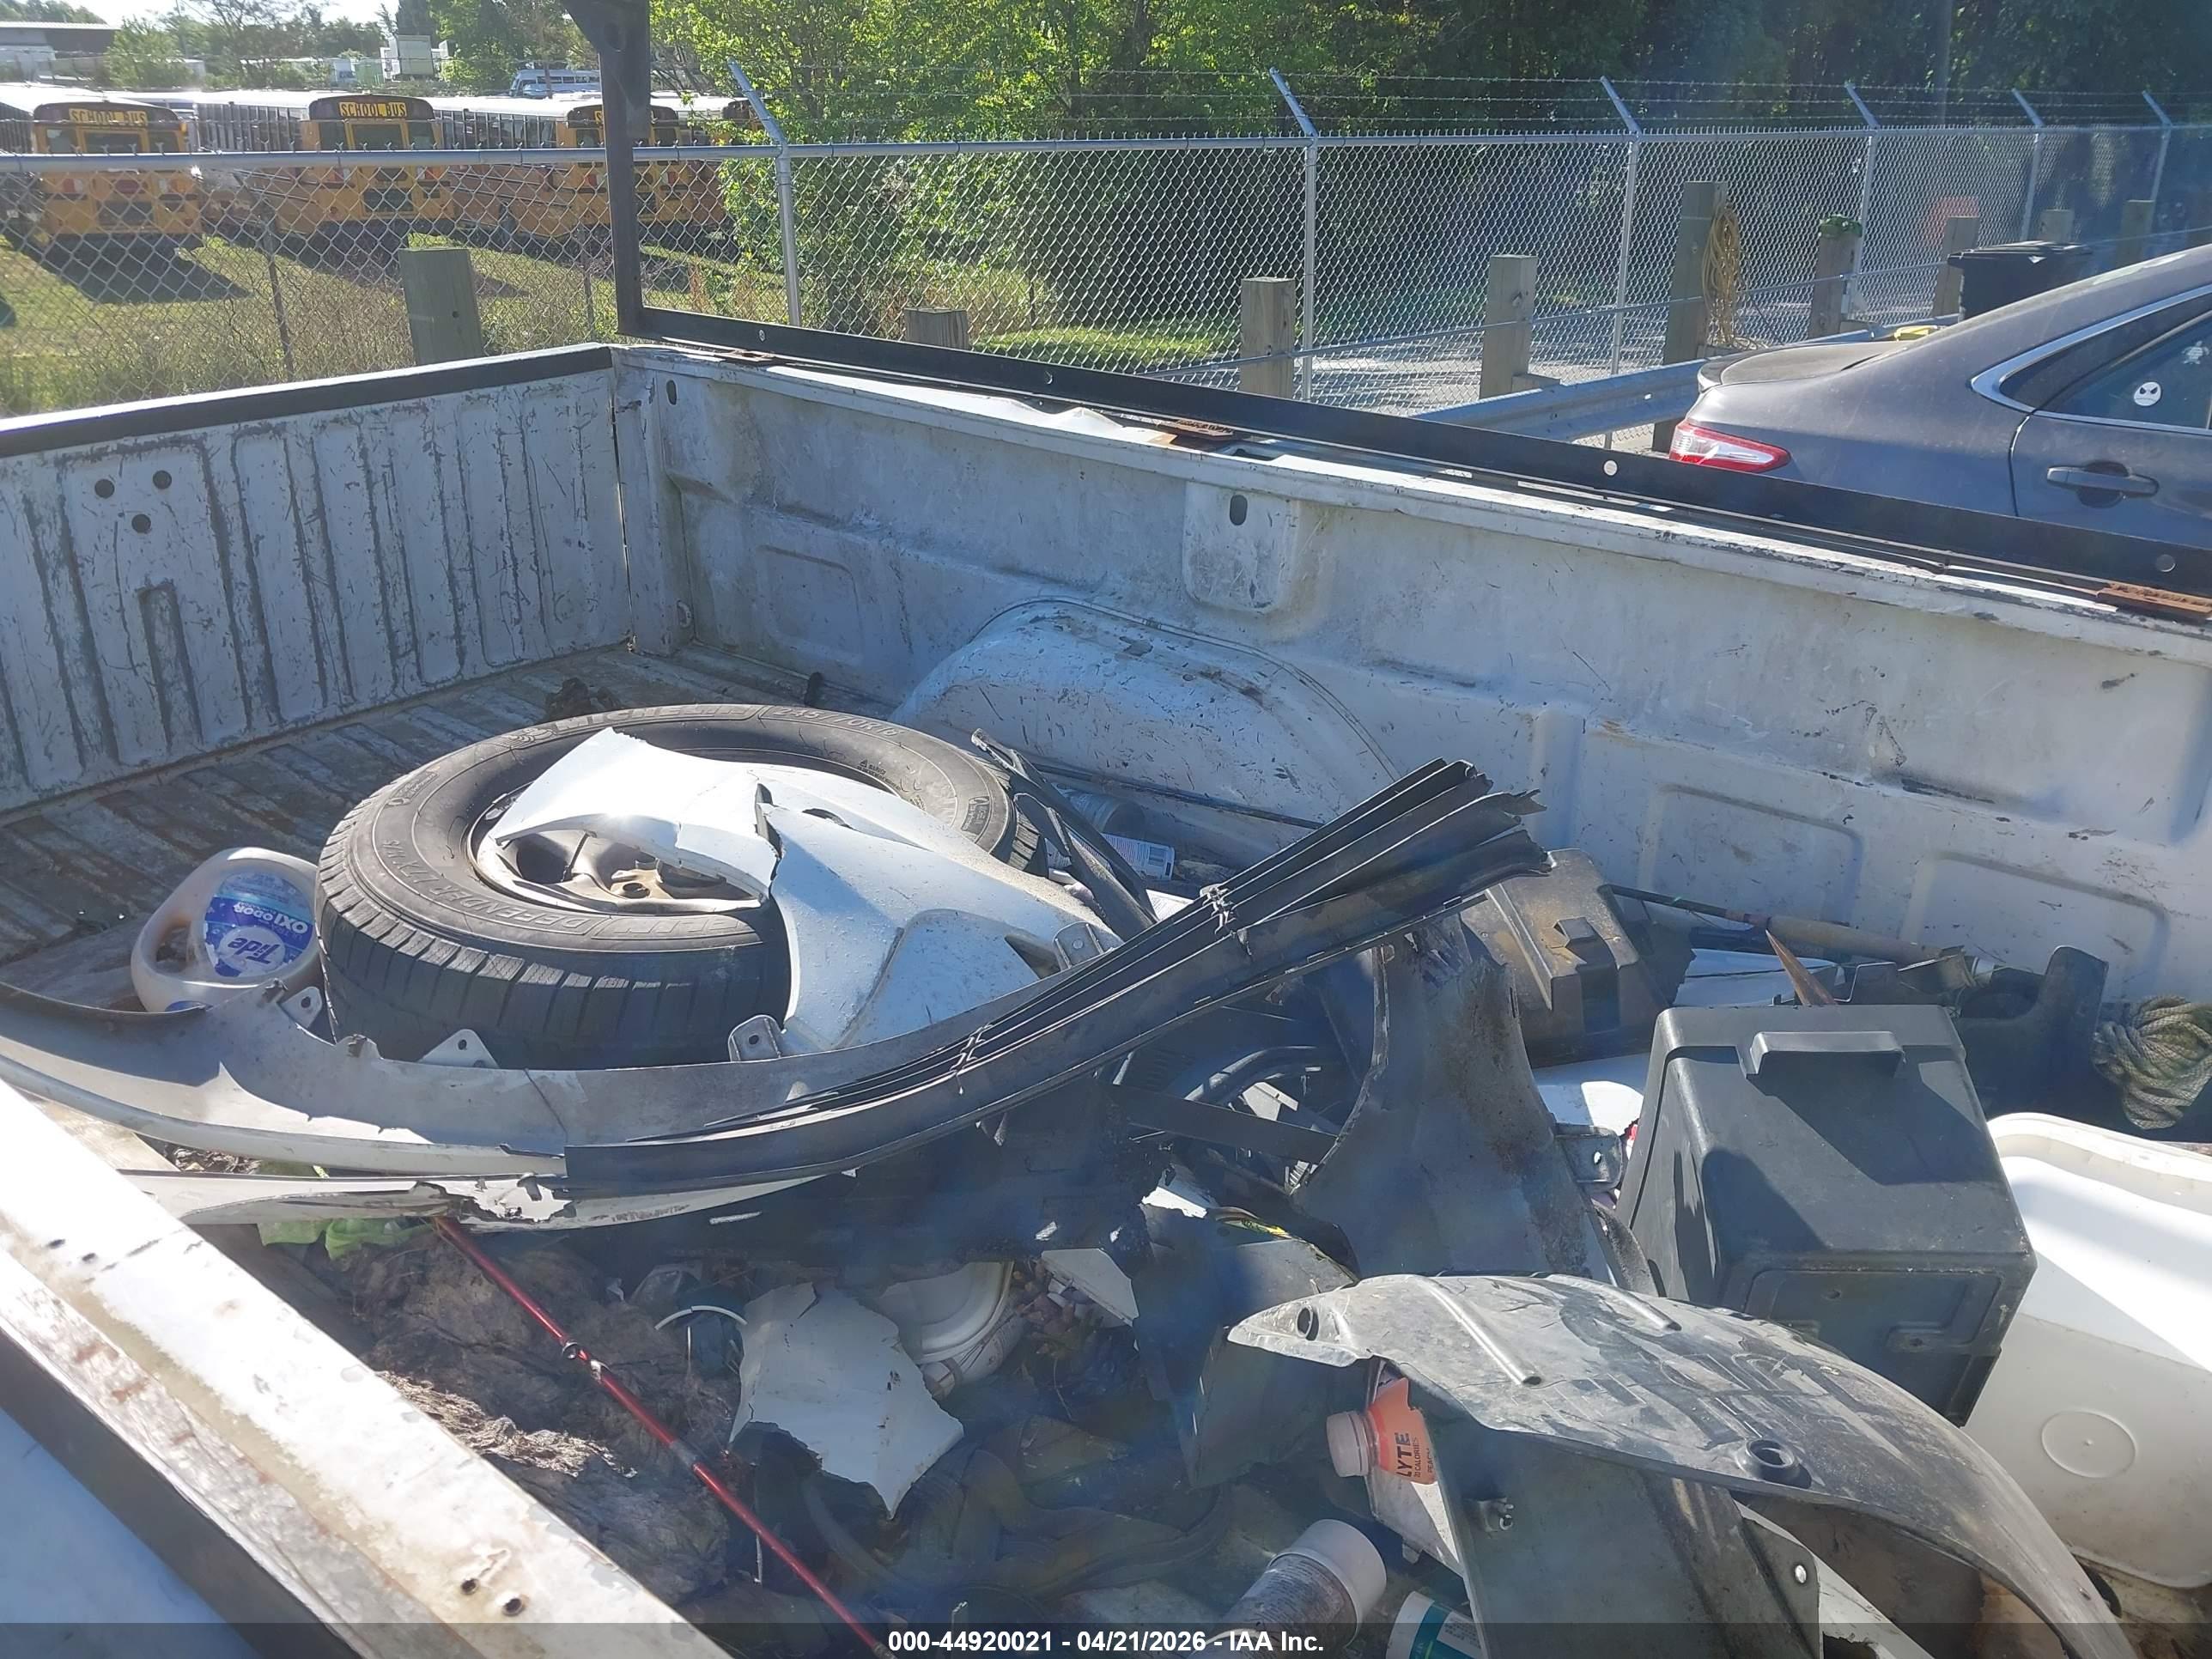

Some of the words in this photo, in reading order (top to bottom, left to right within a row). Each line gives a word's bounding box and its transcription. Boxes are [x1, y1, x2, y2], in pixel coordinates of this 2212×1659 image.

[70, 109, 120, 123] SCHOOL
[339, 103, 383, 117] SCHOOL
[386, 103, 406, 117] BUS
[556, 704, 756, 730] MICHELIN
[233, 902, 274, 921] ODOR
[429, 884, 592, 929] DEFENDER
[273, 912, 308, 934] OXI
[227, 937, 281, 965] Tide
[1413, 1437, 1422, 1471] CALORIES
